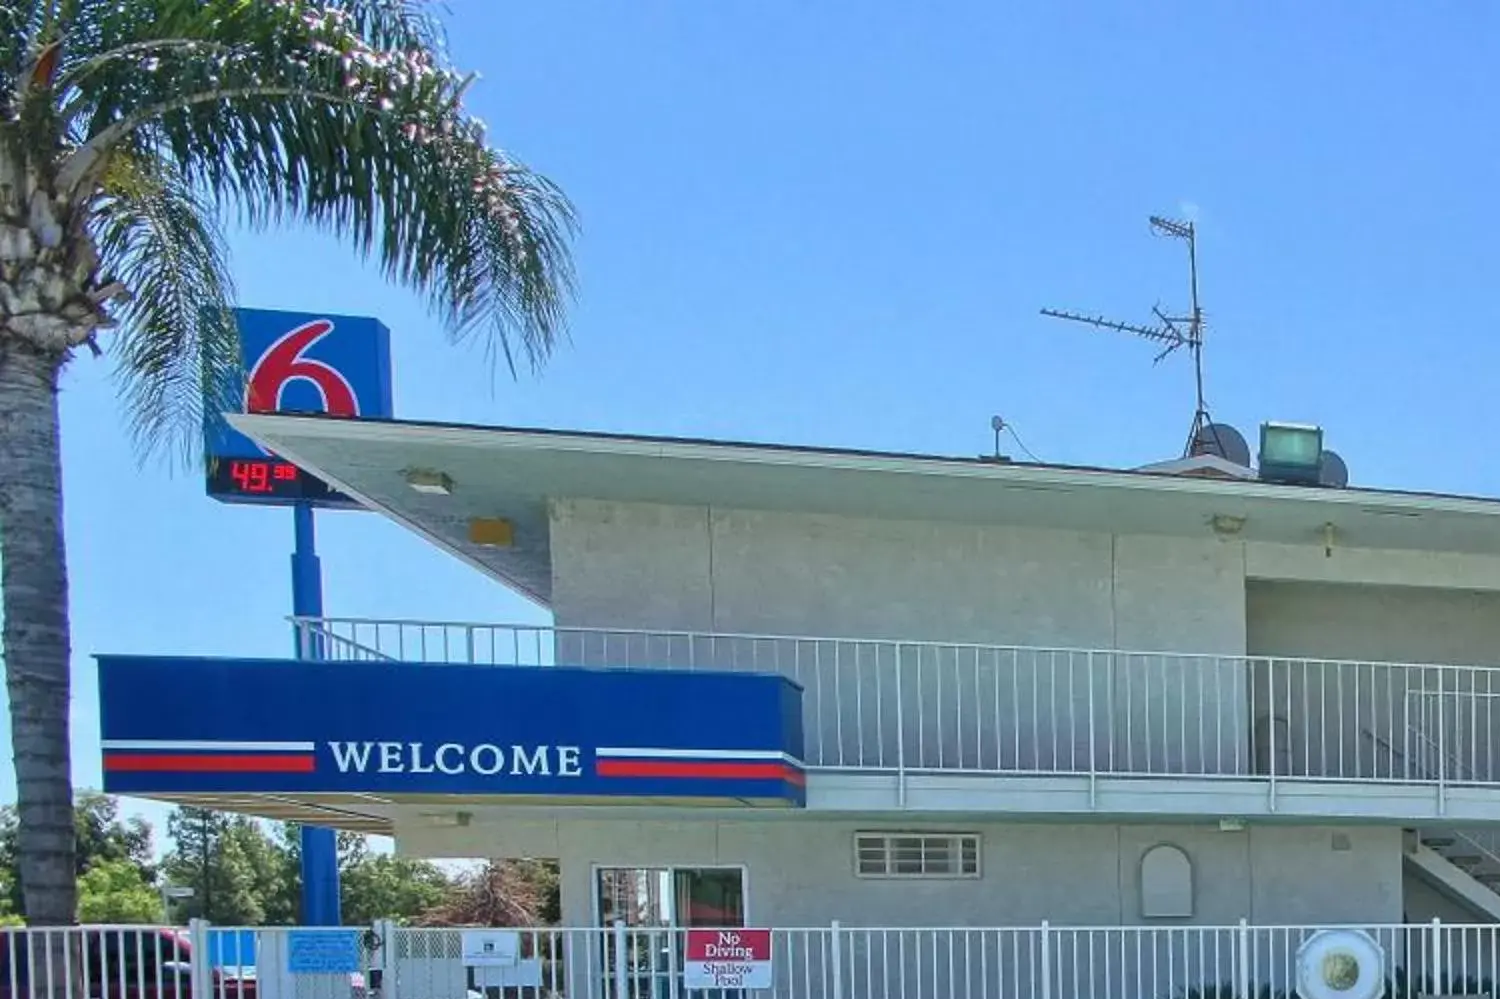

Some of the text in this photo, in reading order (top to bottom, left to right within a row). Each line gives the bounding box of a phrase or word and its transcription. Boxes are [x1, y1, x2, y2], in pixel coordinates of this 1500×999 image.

[242, 319, 361, 456] 6
[328, 740, 582, 776] WELCOME
[718, 931, 741, 945] No
[704, 943, 754, 960] Diving
[703, 962, 753, 975] Shallow
[714, 974, 743, 986] Pool
